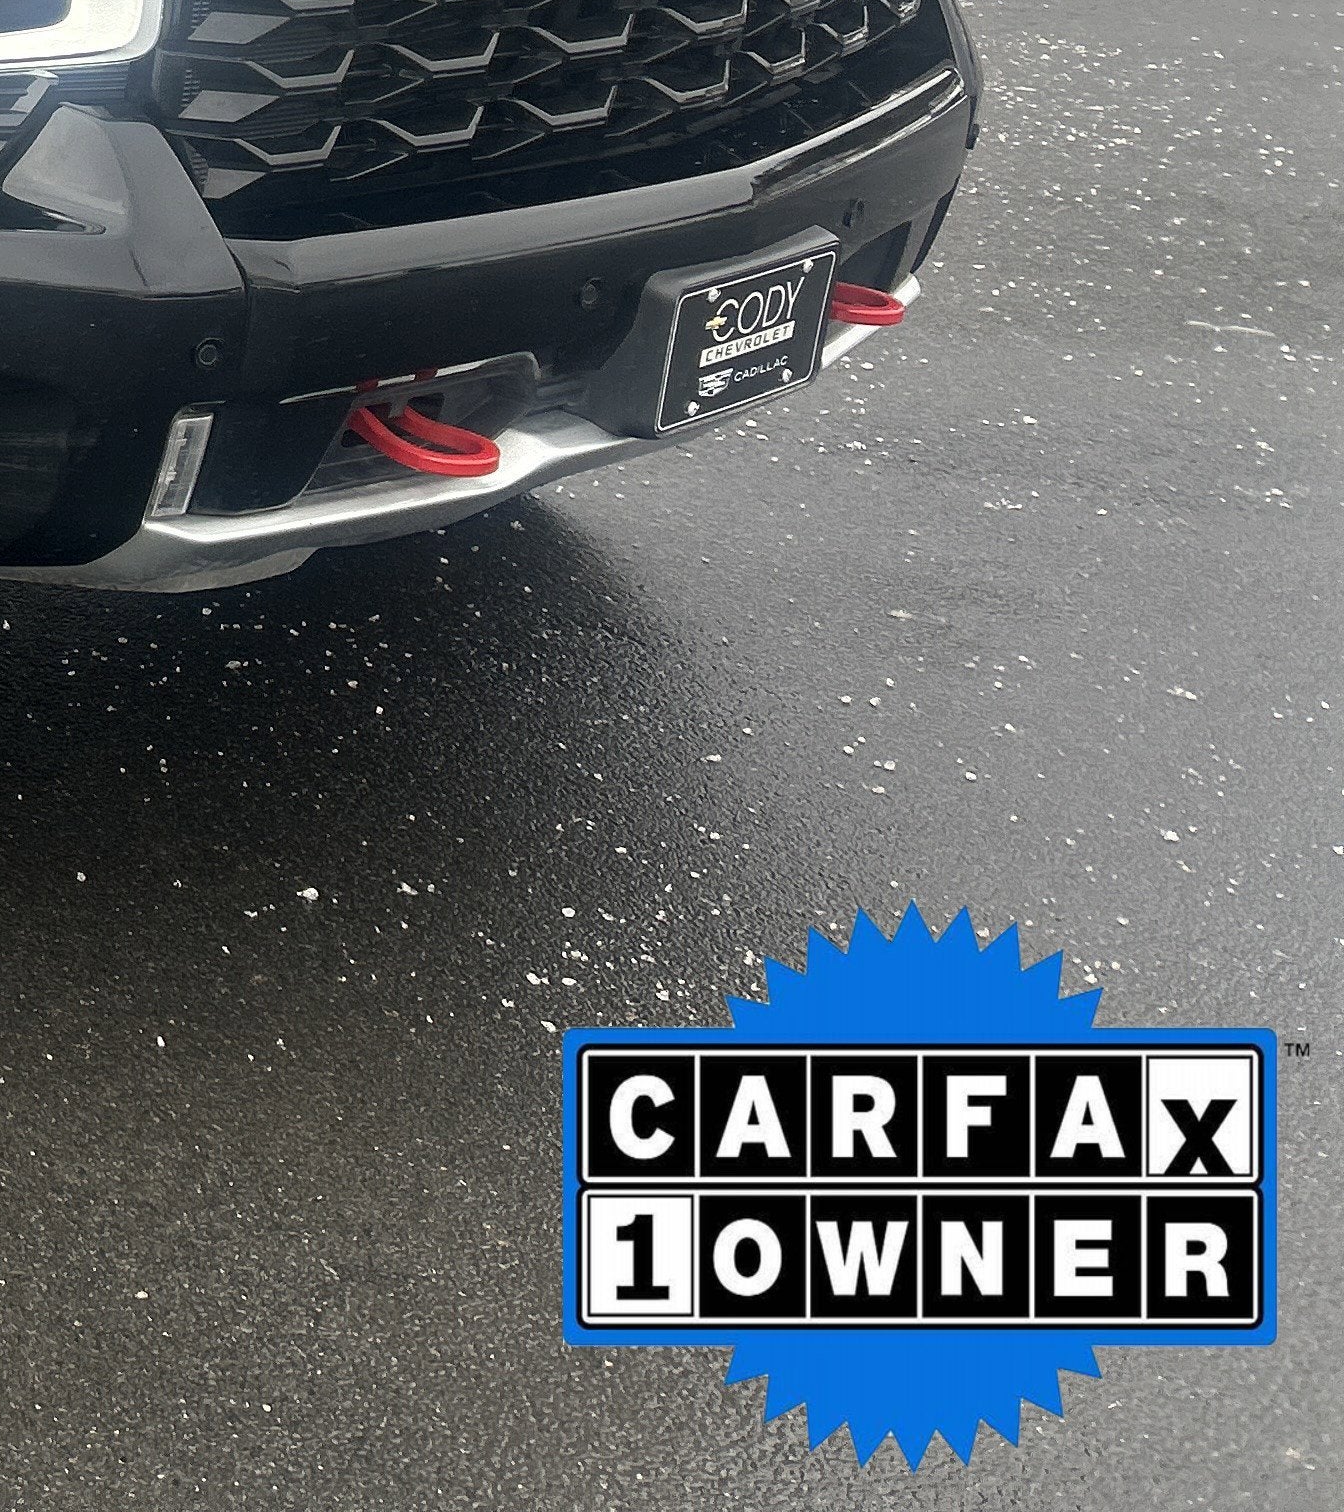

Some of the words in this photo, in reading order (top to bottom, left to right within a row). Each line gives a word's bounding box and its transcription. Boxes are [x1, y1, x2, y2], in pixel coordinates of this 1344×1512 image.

[712, 276, 805, 342] CODY
[705, 325, 790, 362] CHEVROLET
[733, 355, 789, 382] CADILLAC
